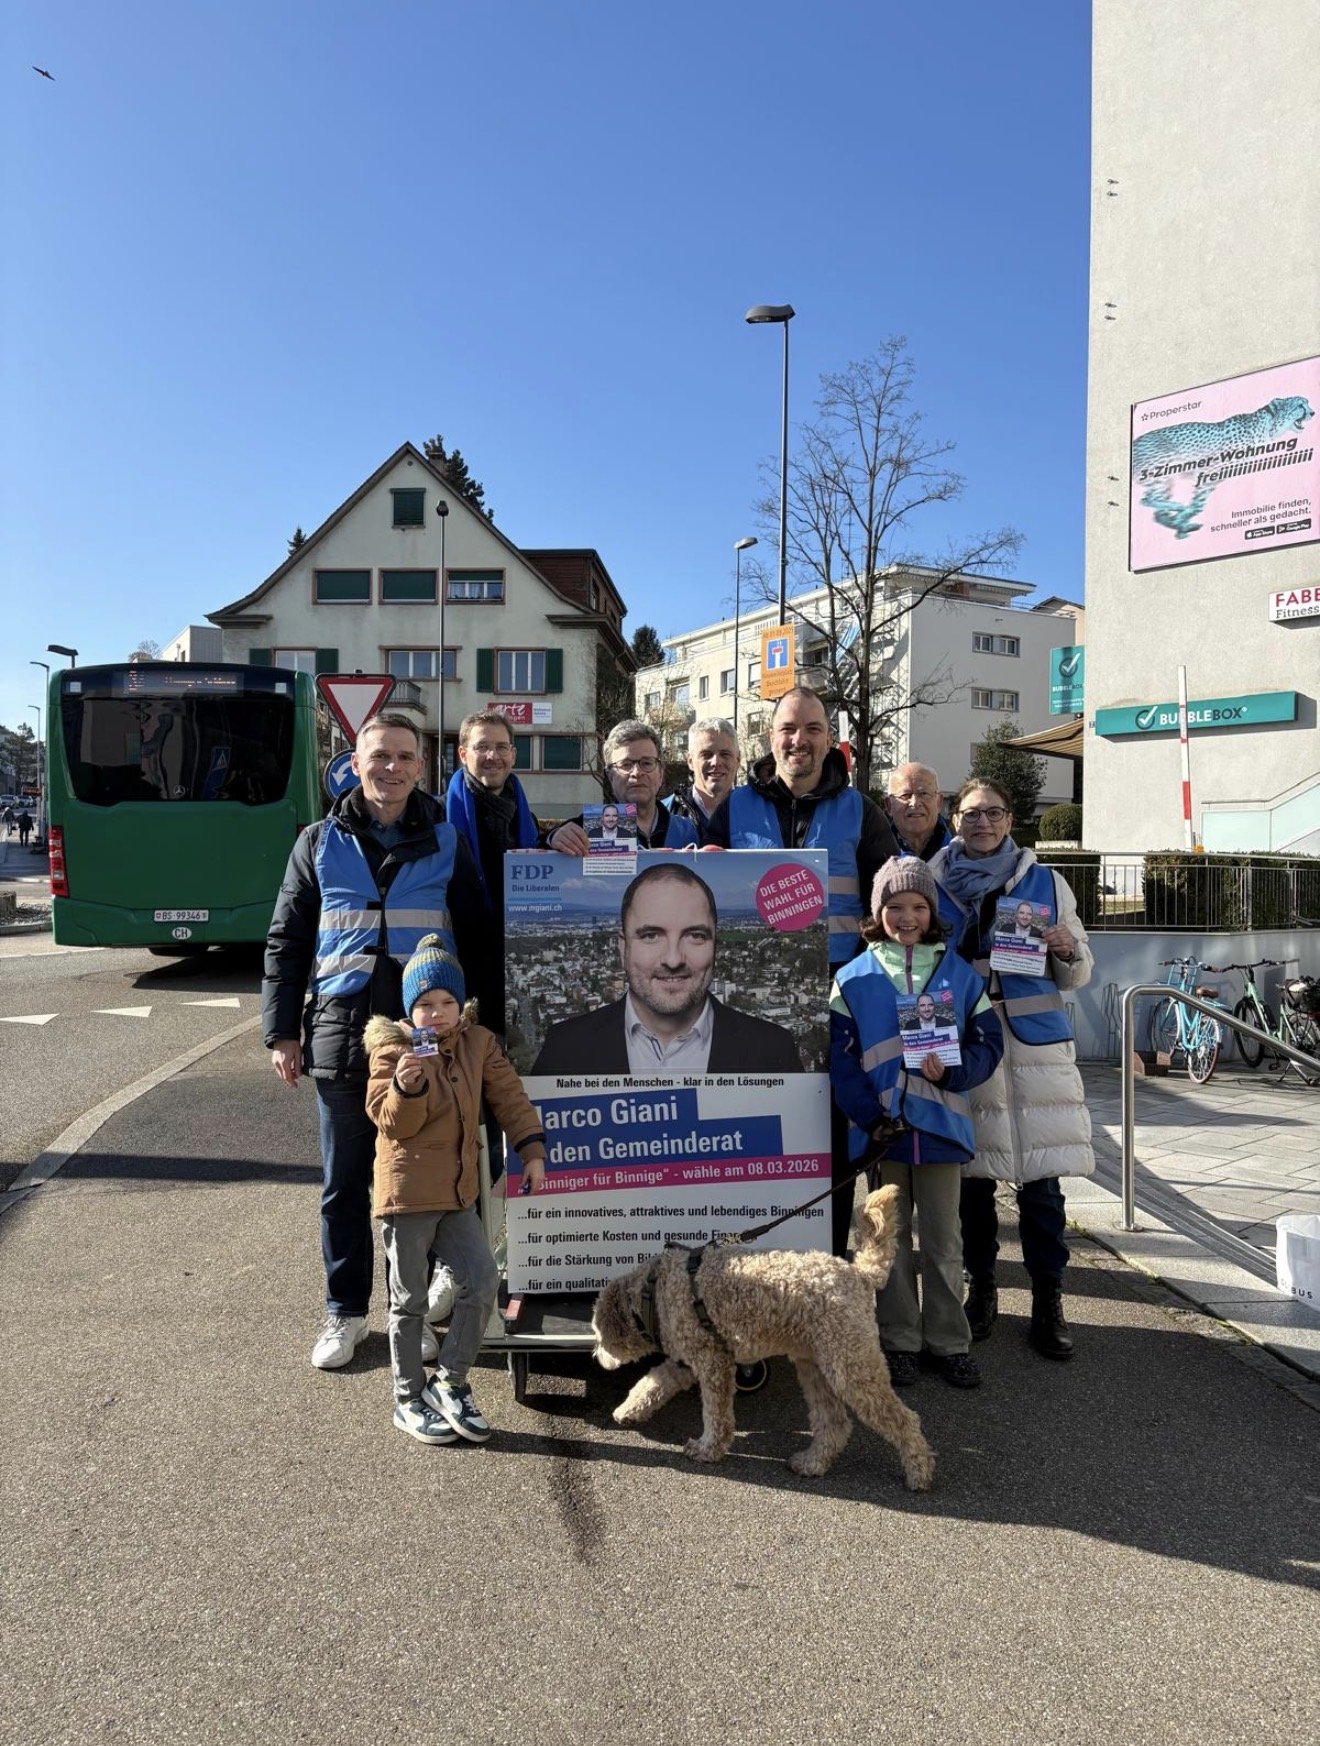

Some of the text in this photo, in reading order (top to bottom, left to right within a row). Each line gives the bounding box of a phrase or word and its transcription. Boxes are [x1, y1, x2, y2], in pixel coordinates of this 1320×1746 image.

[1150, 402, 1202, 419] Properstar
[1140, 438, 1297, 480] 3-Zimmer-Wohnung
[1232, 498, 1311, 518] Immobilie finden,
[1210, 507, 1311, 532] schneller als gedacht.
[1276, 605, 1320, 618] Fitness
[1160, 708, 1242, 725] BUBLEBOX
[511, 864, 554, 880] FDP
[760, 870, 808, 897] DIE BESTE
[764, 884, 816, 910] WAHL FÜR
[768, 894, 823, 924] BINNINGEN
[175, 929, 187, 938] CH
[557, 1079, 582, 1088] Nahe
[585, 1078, 599, 1087] bei
[602, 1078, 620, 1087] den
[623, 1078, 673, 1087] Menschen
[684, 1077, 701, 1086] klar
[705, 1077, 714, 1086] in
[717, 1077, 734, 1086] den
[738, 1077, 784, 1088] Lösungen
[611, 1096, 677, 1124] Giani
[550, 1131, 743, 1163] den Gemeinderat
[593, 1173, 610, 1185] für
[683, 1166, 720, 1179] wähle
[725, 1167, 743, 1176] am
[748, 1160, 819, 1174] 08.03.2026
[546, 1208, 561, 1218] ein
[565, 1206, 626, 1218] innovatives,
[630, 1206, 684, 1216] attraktives
[688, 1206, 707, 1216] und
[711, 1205, 767, 1219] lebendiges
[546, 1231, 599, 1244] optimierte
[603, 1230, 638, 1241] Kosten
[642, 1230, 660, 1240] und
[664, 1230, 708, 1242] gesunde
[546, 1255, 562, 1266] die
[565, 1254, 612, 1267] Stärkung
[615, 1256, 634, 1264] von
[546, 1279, 562, 1289] ein
[565, 1277, 611, 1290] qualitati
